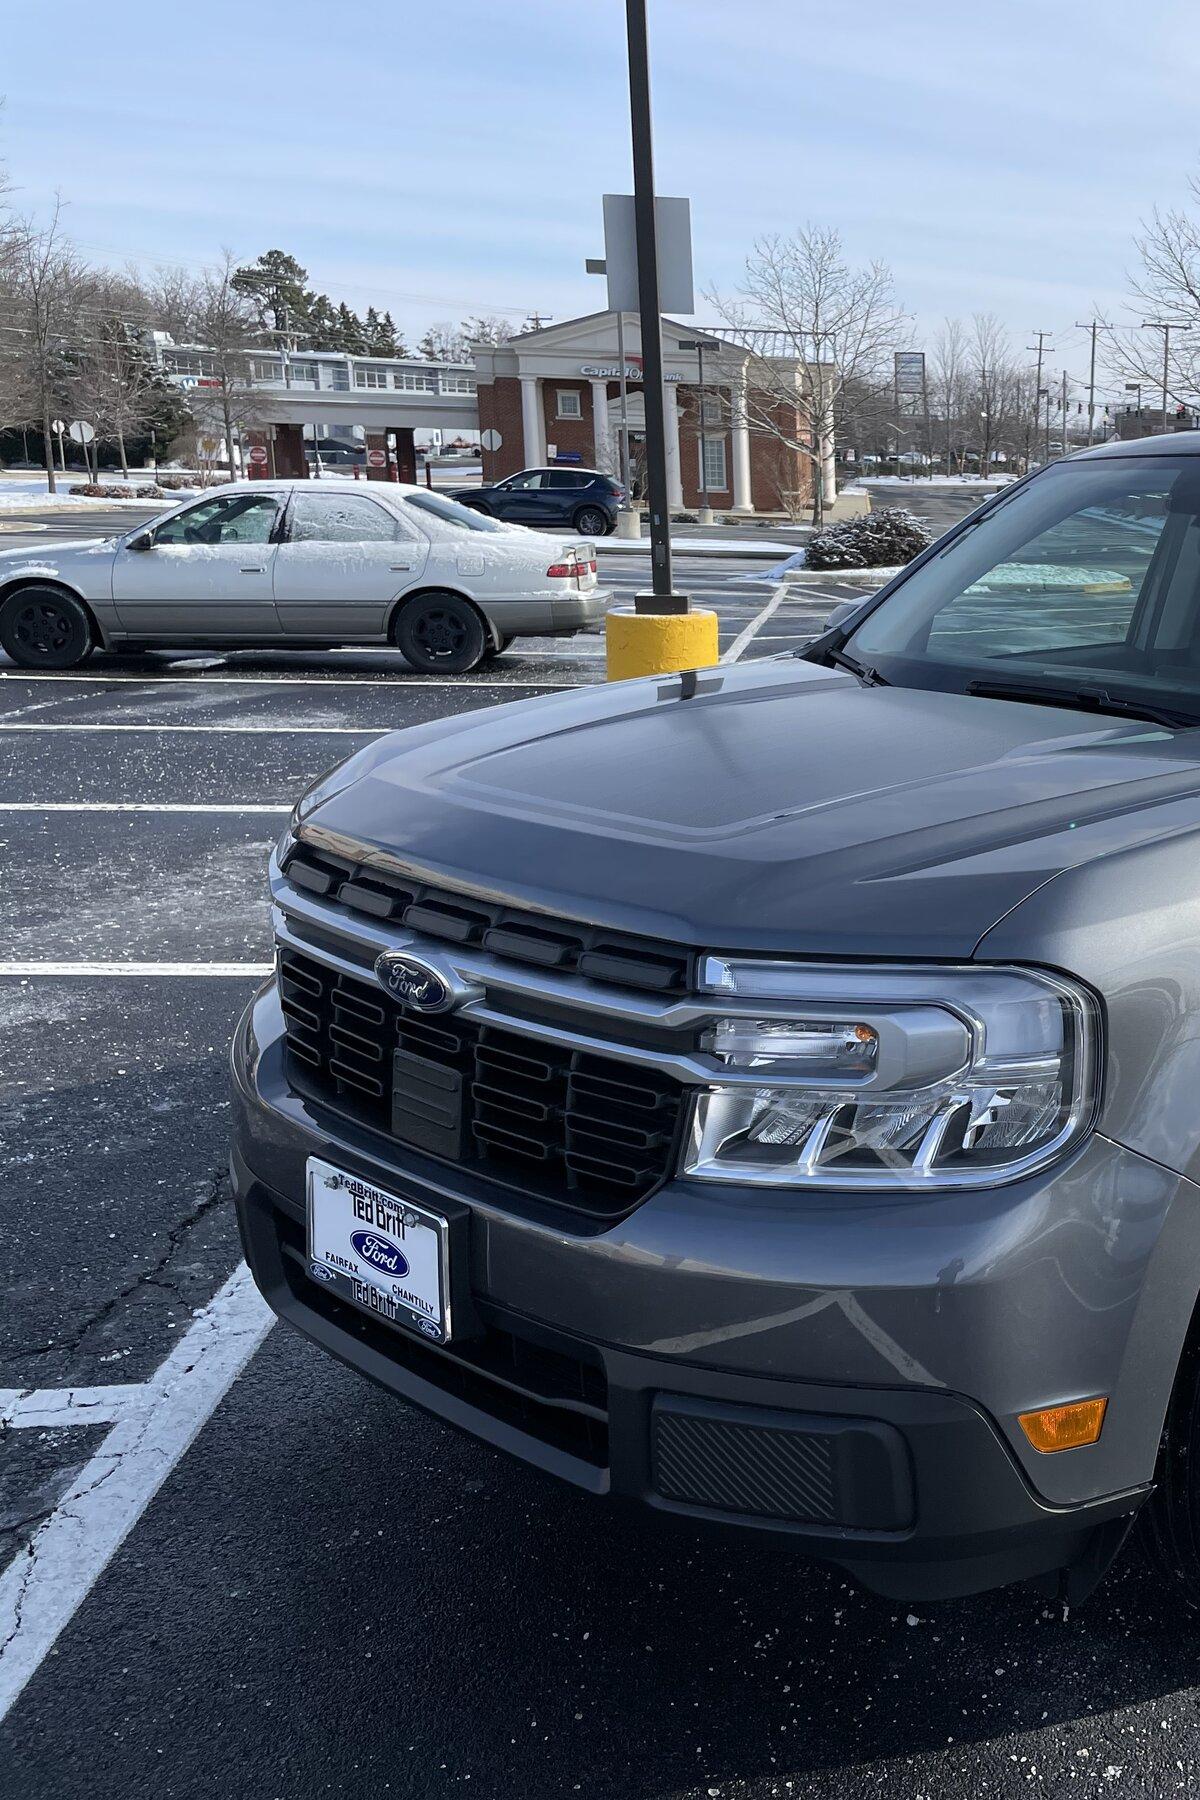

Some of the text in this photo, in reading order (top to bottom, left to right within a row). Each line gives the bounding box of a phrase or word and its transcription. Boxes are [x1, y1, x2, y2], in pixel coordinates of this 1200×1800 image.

[388, 963, 429, 1000] Ford
[338, 1173, 403, 1214] TedBritt.com
[348, 1189, 407, 1241] Ted Britt
[325, 1251, 360, 1275] FAIRFAX
[362, 1236, 398, 1271] Ford
[350, 1276, 399, 1320] Ted Britt
[391, 1284, 434, 1316] CHANTILLY
